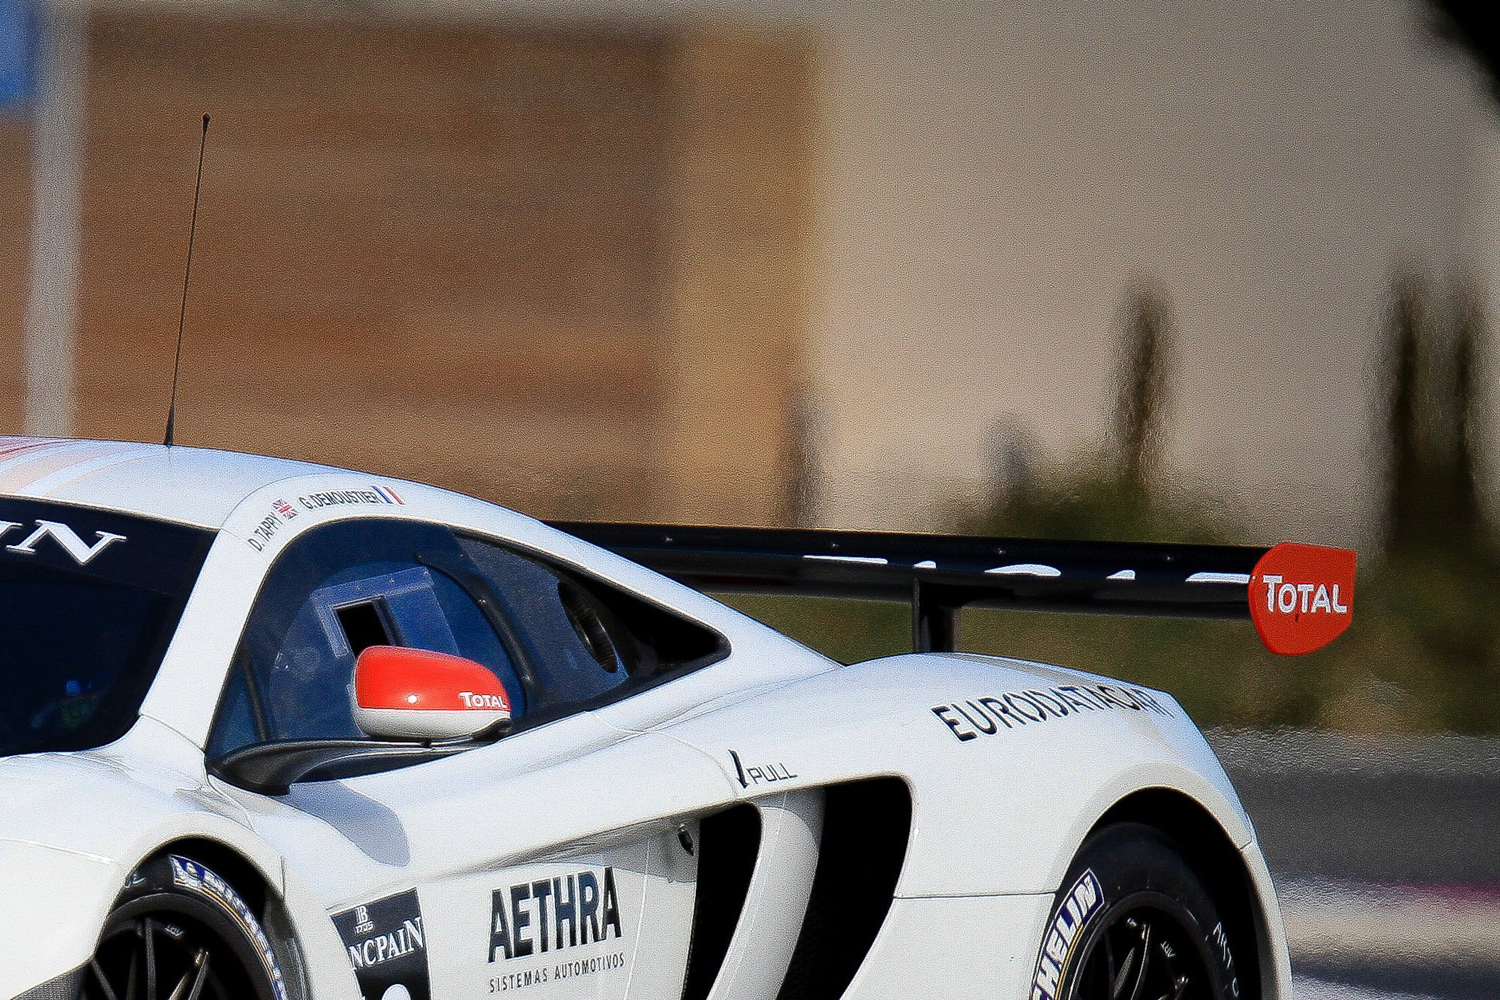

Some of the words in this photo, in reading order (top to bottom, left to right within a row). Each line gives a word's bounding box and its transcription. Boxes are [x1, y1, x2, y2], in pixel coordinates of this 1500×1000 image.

[1263, 574, 1348, 613] TOTAL
[458, 691, 508, 709] TOTAL
[931, 684, 1176, 742] EURODATACAR
[746, 762, 799, 784] PULL
[487, 866, 622, 963] AETHRA
[488, 967, 549, 994] SISTEMAS
[554, 952, 626, 981] AUTOMOTIVOS
